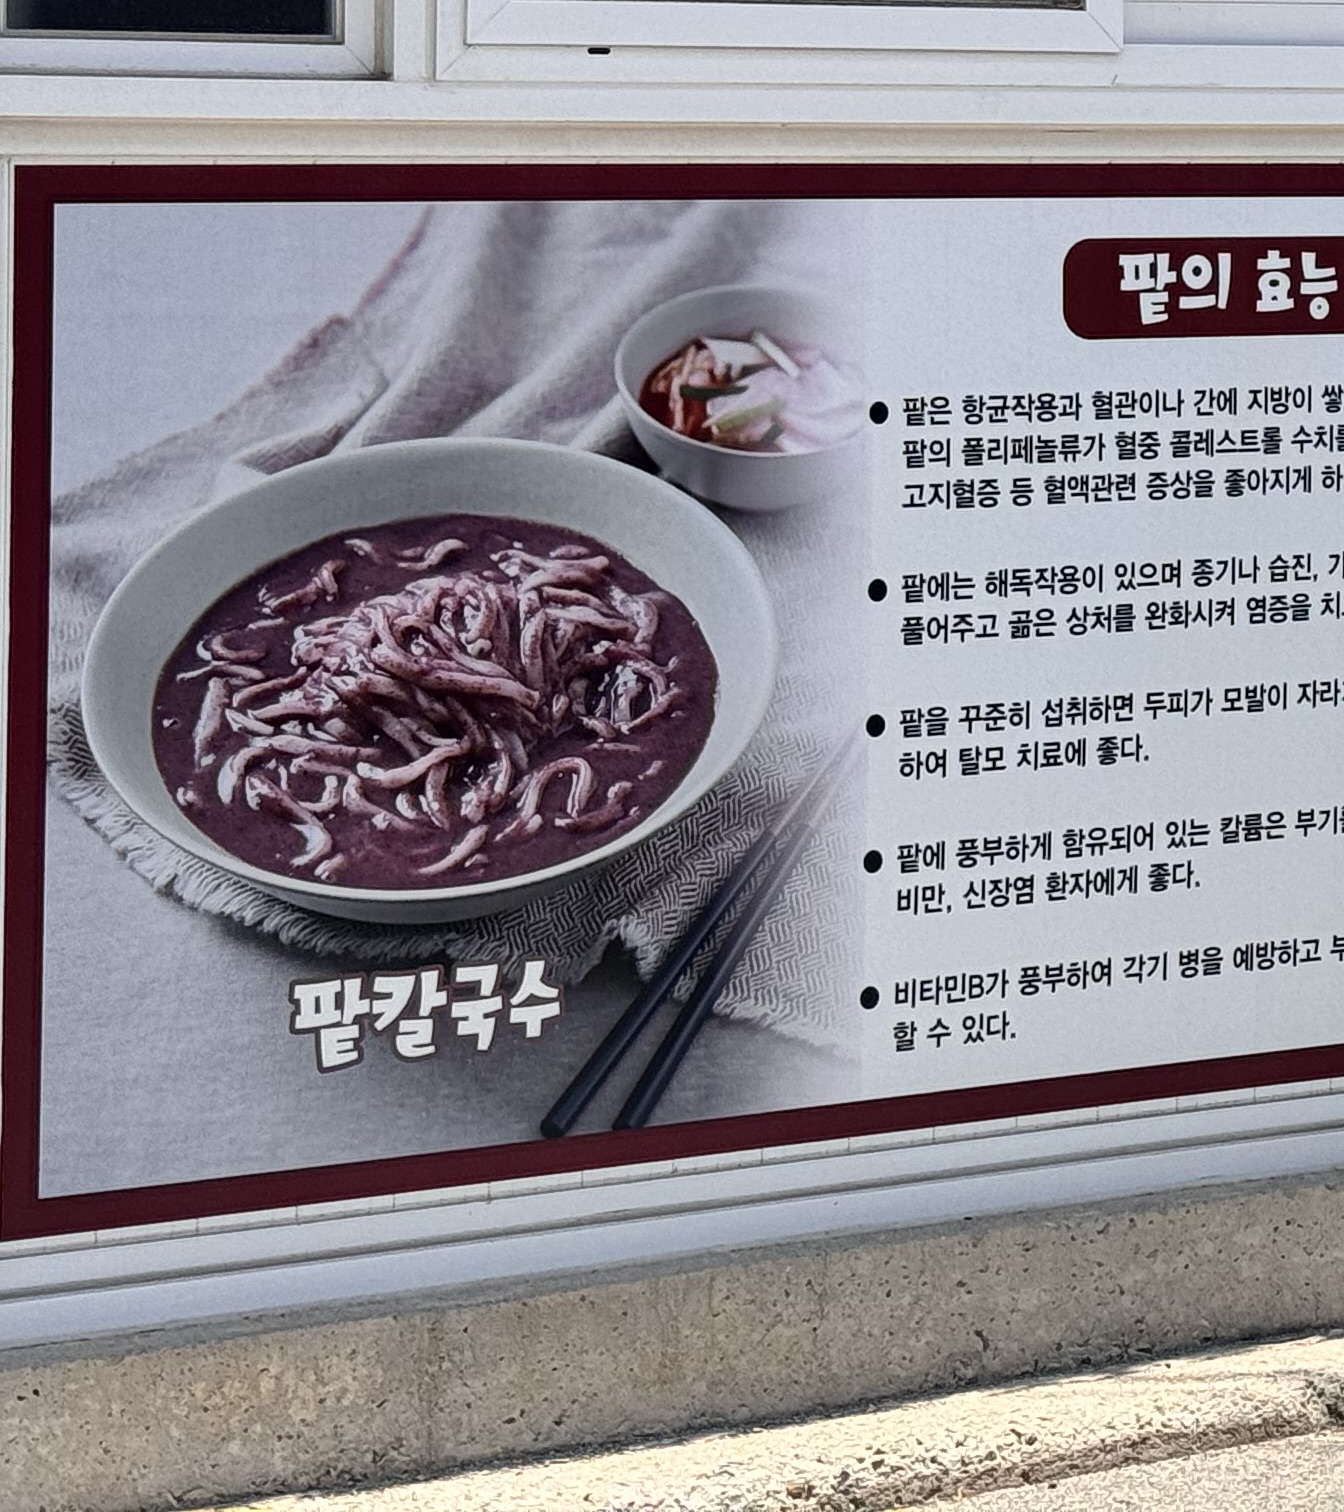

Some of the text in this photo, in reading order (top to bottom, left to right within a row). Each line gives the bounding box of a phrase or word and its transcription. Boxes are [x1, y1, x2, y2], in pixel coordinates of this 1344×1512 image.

[1119, 249, 1338, 325] 팥의 효능
[902, 395, 953, 427] 팥은
[961, 391, 1084, 426] 항균작용과
[1091, 388, 1186, 421] 혈관이나
[1193, 386, 1238, 417] 간에
[1247, 384, 1313, 416] 지방이
[901, 437, 952, 470] 팥의
[960, 432, 1107, 467] 폴리페놀류가
[1114, 430, 1162, 461] 혈중
[1169, 426, 1284, 459] 콜레스트롤
[901, 478, 1002, 511] 고지혈증
[1009, 477, 1035, 507] 등
[1043, 471, 1137, 506] 혈액관련
[1145, 469, 1216, 501] 증상을
[1223, 464, 1312, 498] 좋아지게
[900, 570, 977, 604] 팥에는
[984, 563, 1104, 599] 해독작용이
[1114, 558, 1182, 592] 있으며
[1190, 554, 1261, 588] 종기나
[1267, 552, 1319, 584] 습진,
[900, 613, 1000, 646] 풀어주고
[1007, 607, 1058, 640] 곪은
[1065, 603, 1137, 636] 상처를
[1144, 596, 1236, 631] 완화시켜
[1245, 592, 1313, 625] 염증을
[898, 706, 950, 739] 팥을
[957, 699, 1031, 735] 꾸준히
[1041, 692, 1134, 728] 섭취하면
[1143, 686, 1214, 721] 두피가
[1220, 681, 1288, 714] 모발이
[898, 732, 1150, 781] 하여 탈모 치료에 좋다.
[896, 840, 946, 875] 팥에
[955, 830, 1053, 869] 풍부하게
[1062, 821, 1155, 859] 함유되어
[1165, 818, 1211, 850] 있는
[1219, 810, 1288, 845] 칼륨은
[896, 859, 1201, 916] 비만, 신장염 환자에게 좋다.
[894, 968, 1010, 1009] 비타민B가
[1017, 956, 1112, 996] 풍부하여
[1122, 951, 1168, 985] 각기
[1178, 946, 1224, 979] 병을
[1232, 937, 1322, 972] 예방하고
[291, 960, 562, 1071] 팥칼국수
[892, 1010, 1017, 1053] 할 수 있다.
